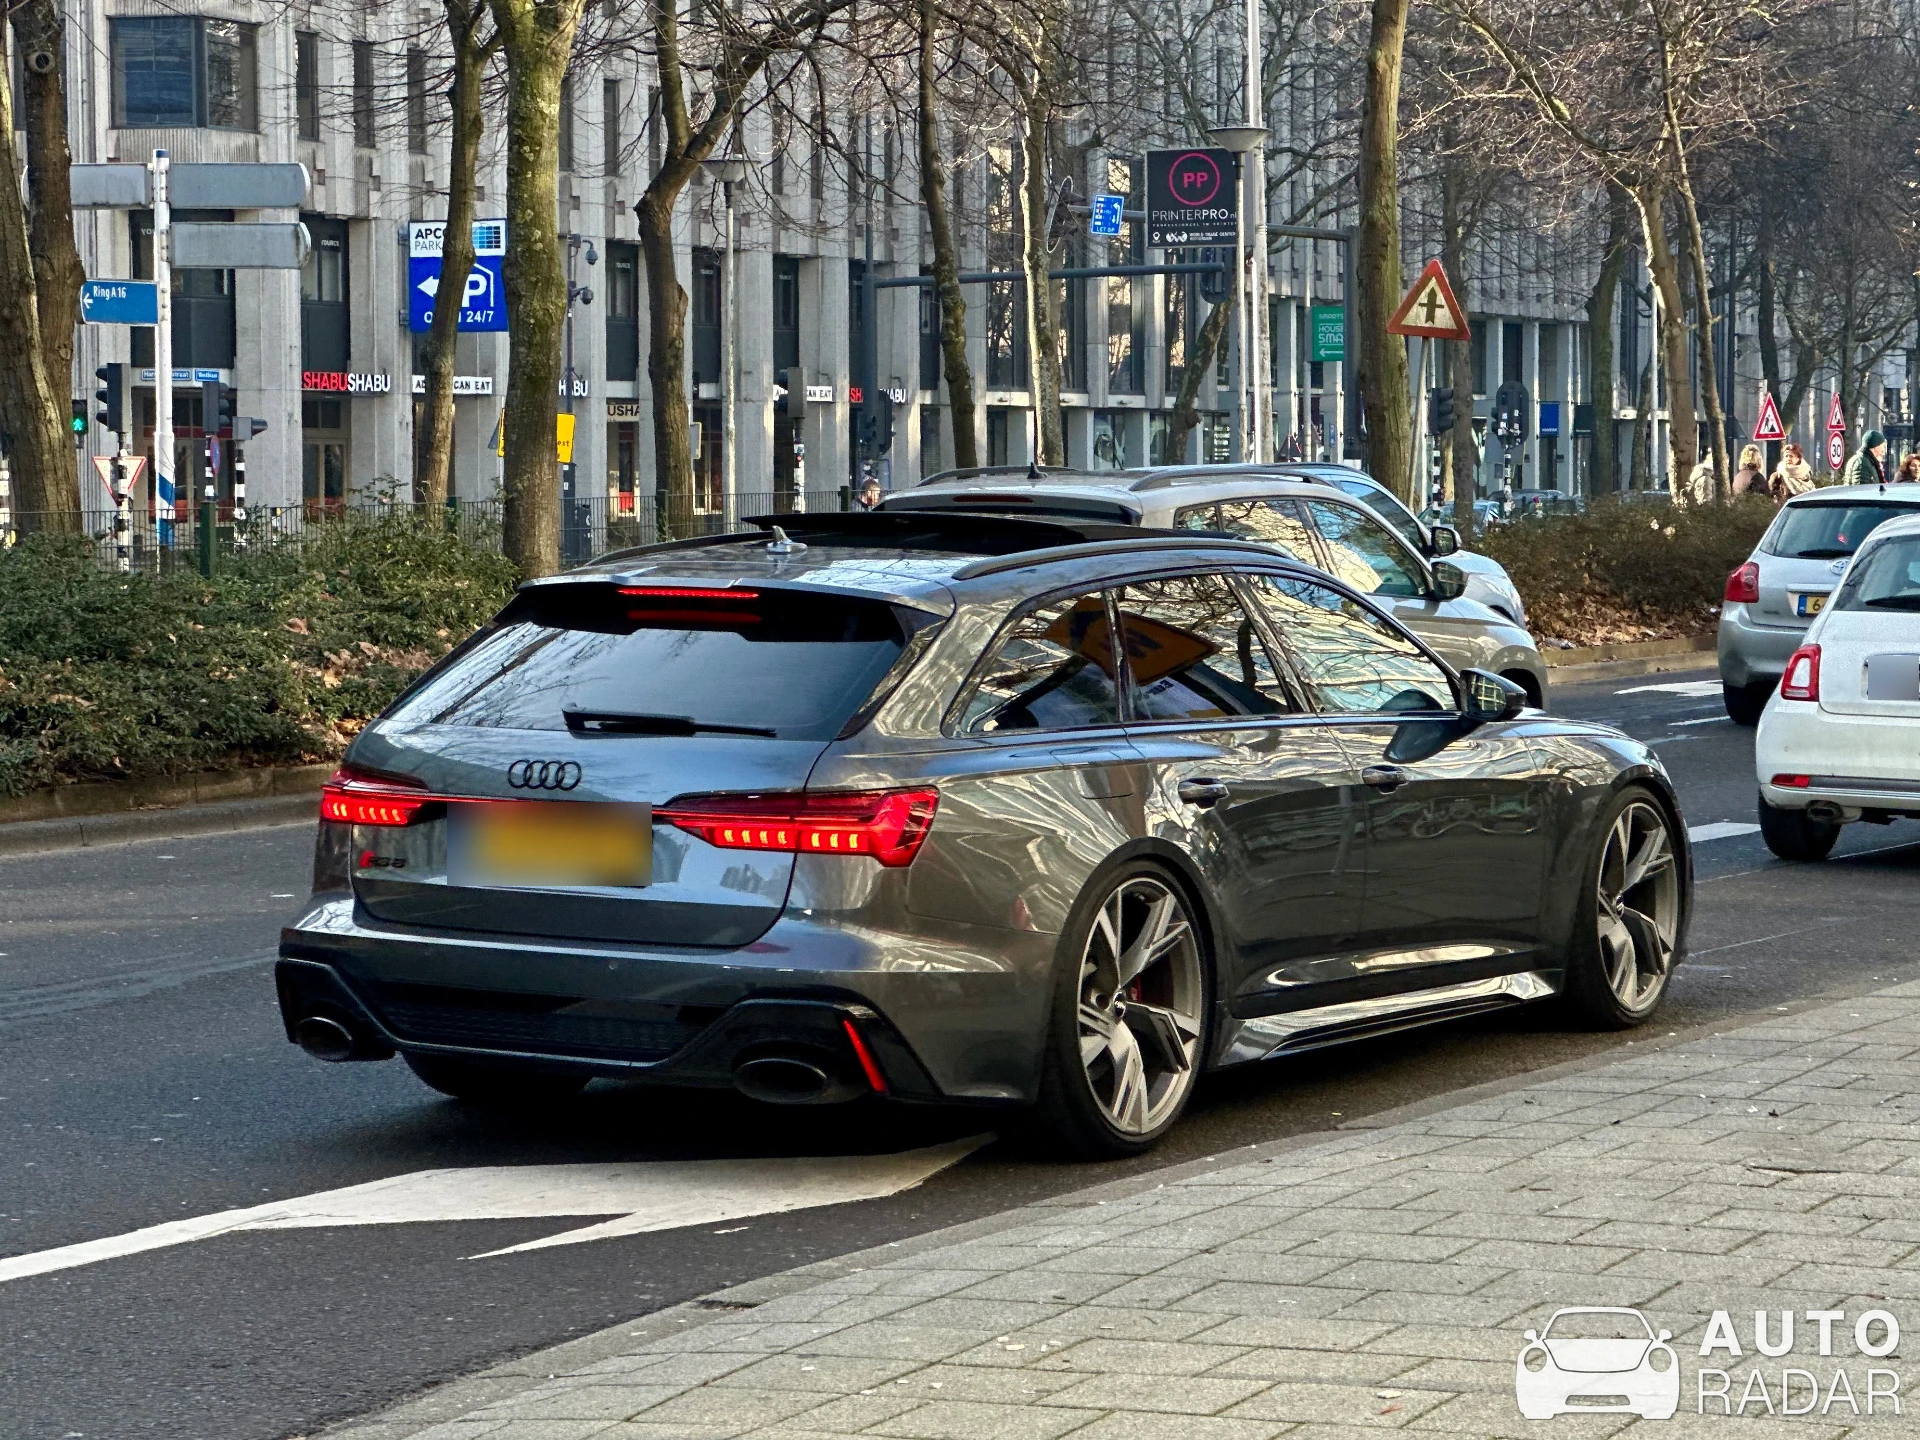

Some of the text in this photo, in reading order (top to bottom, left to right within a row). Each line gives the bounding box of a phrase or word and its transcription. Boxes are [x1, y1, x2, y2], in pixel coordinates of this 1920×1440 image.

[1183, 172, 1208, 188] PP
[1152, 209, 1228, 220] PRINTERPRO
[415, 228, 447, 240] APC
[93, 285, 110, 301] Ring
[466, 310, 494, 323] 24/7
[453, 380, 490, 390] CAN EAT
[559, 379, 588, 397] HBU
[1831, 443, 1842, 458] 30
